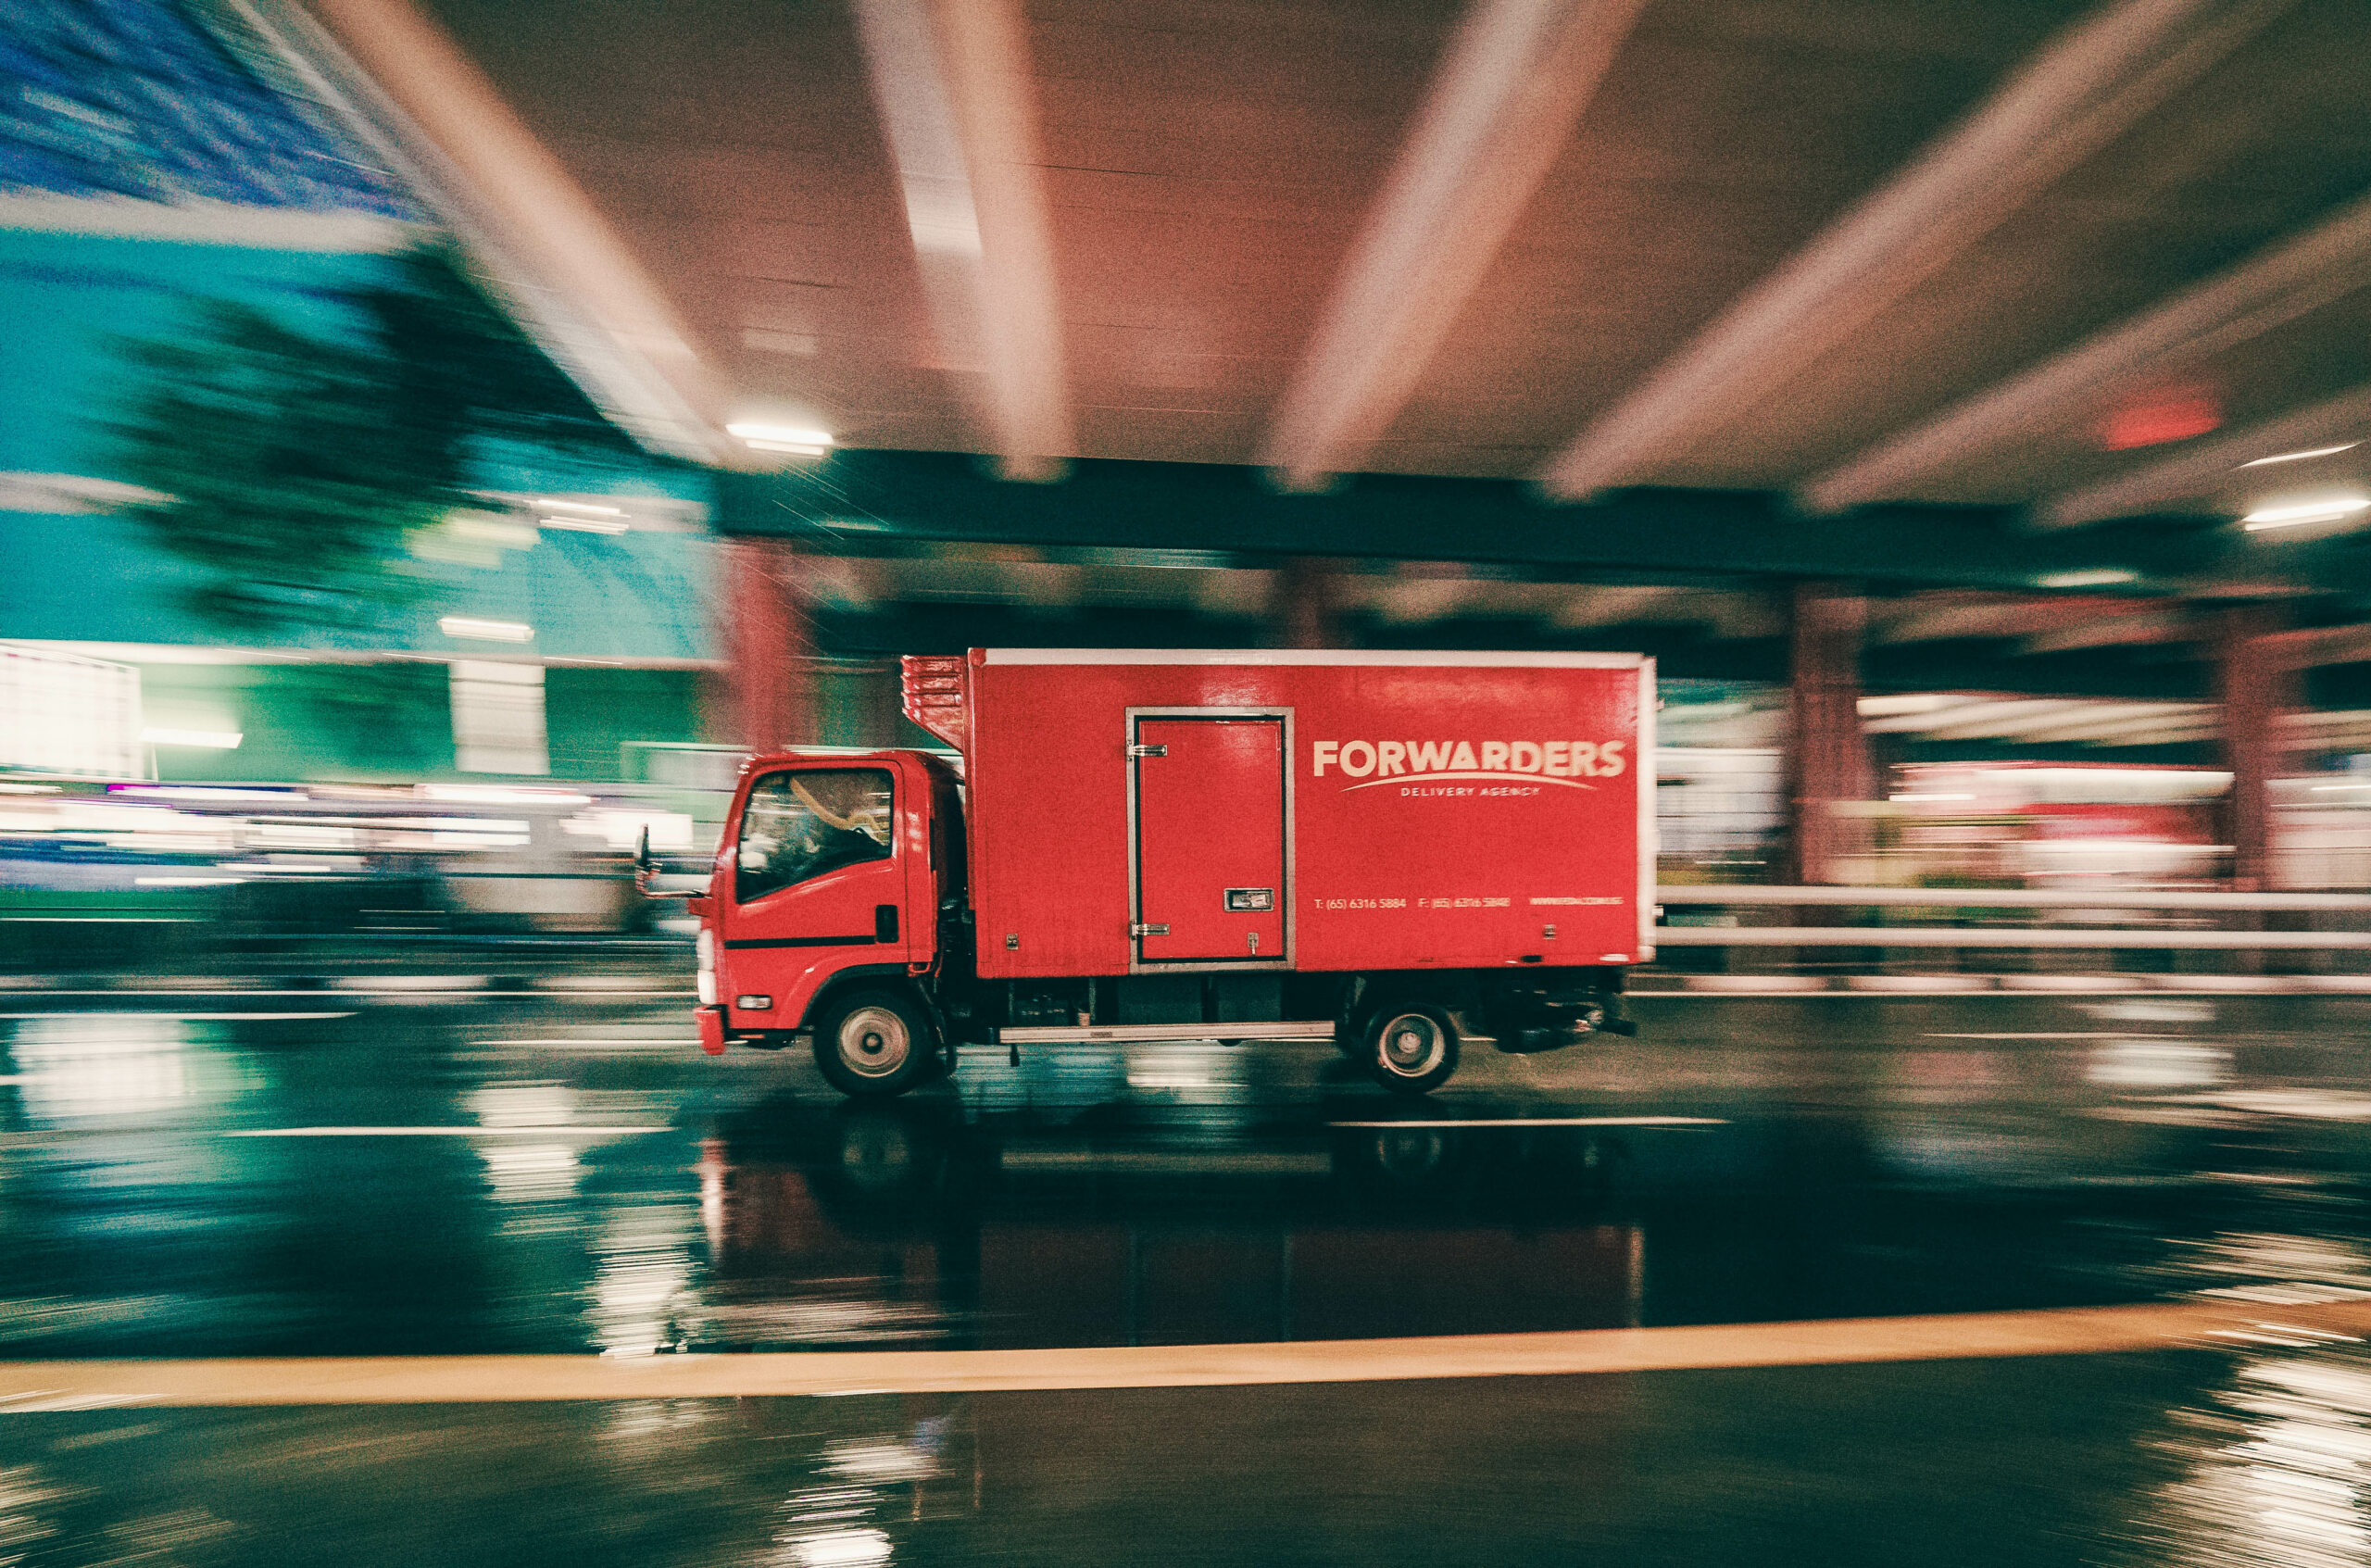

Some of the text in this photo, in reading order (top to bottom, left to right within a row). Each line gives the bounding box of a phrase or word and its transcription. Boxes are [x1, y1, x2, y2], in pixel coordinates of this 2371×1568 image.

[1313, 740, 1625, 777] FORWARDERS
[1400, 786, 1541, 797] DELIVERY AGENCY
[1313, 897, 1407, 910] T: (65) 6316 5884
